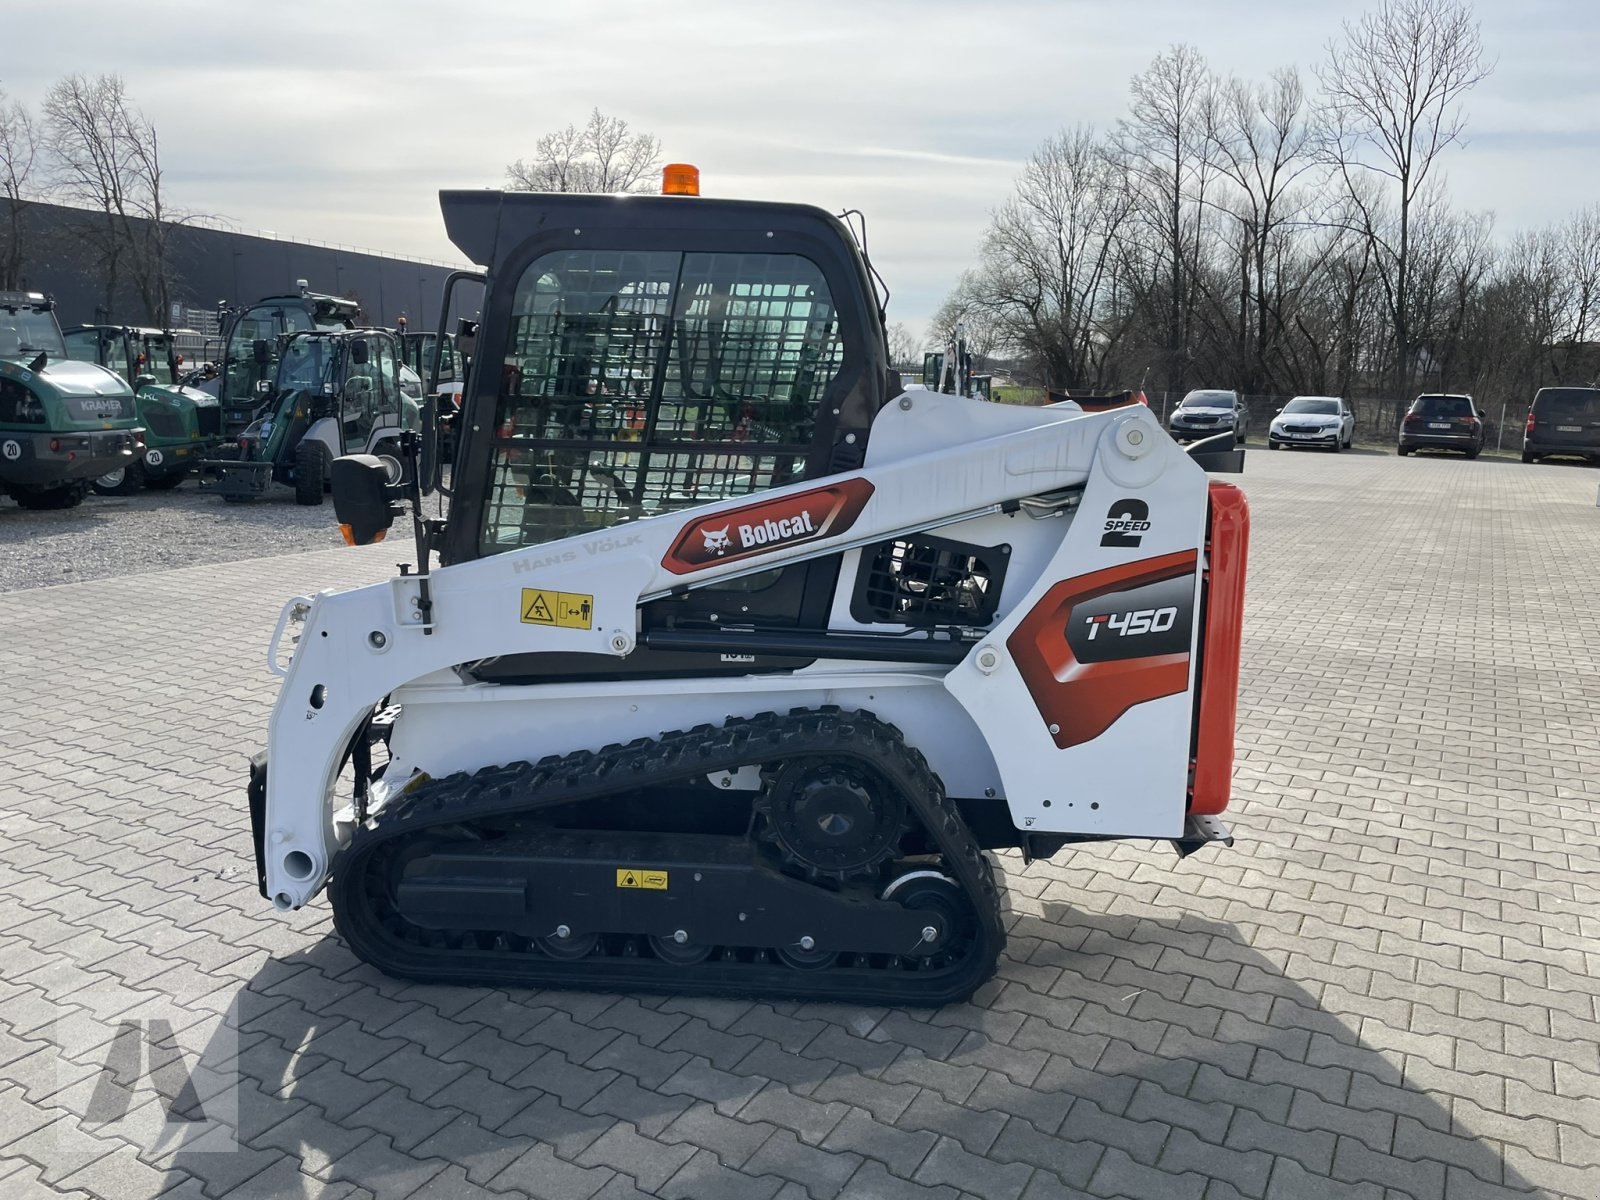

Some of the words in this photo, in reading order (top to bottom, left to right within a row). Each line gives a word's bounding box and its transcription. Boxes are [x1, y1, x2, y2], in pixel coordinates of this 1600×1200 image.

[81, 399, 122, 412] KRAMER
[6, 443, 17, 456] 20
[149, 451, 160, 463] 20
[738, 510, 815, 549] Bobcat
[1104, 520, 1151, 531] SPEED
[1085, 606, 1179, 641] T450
